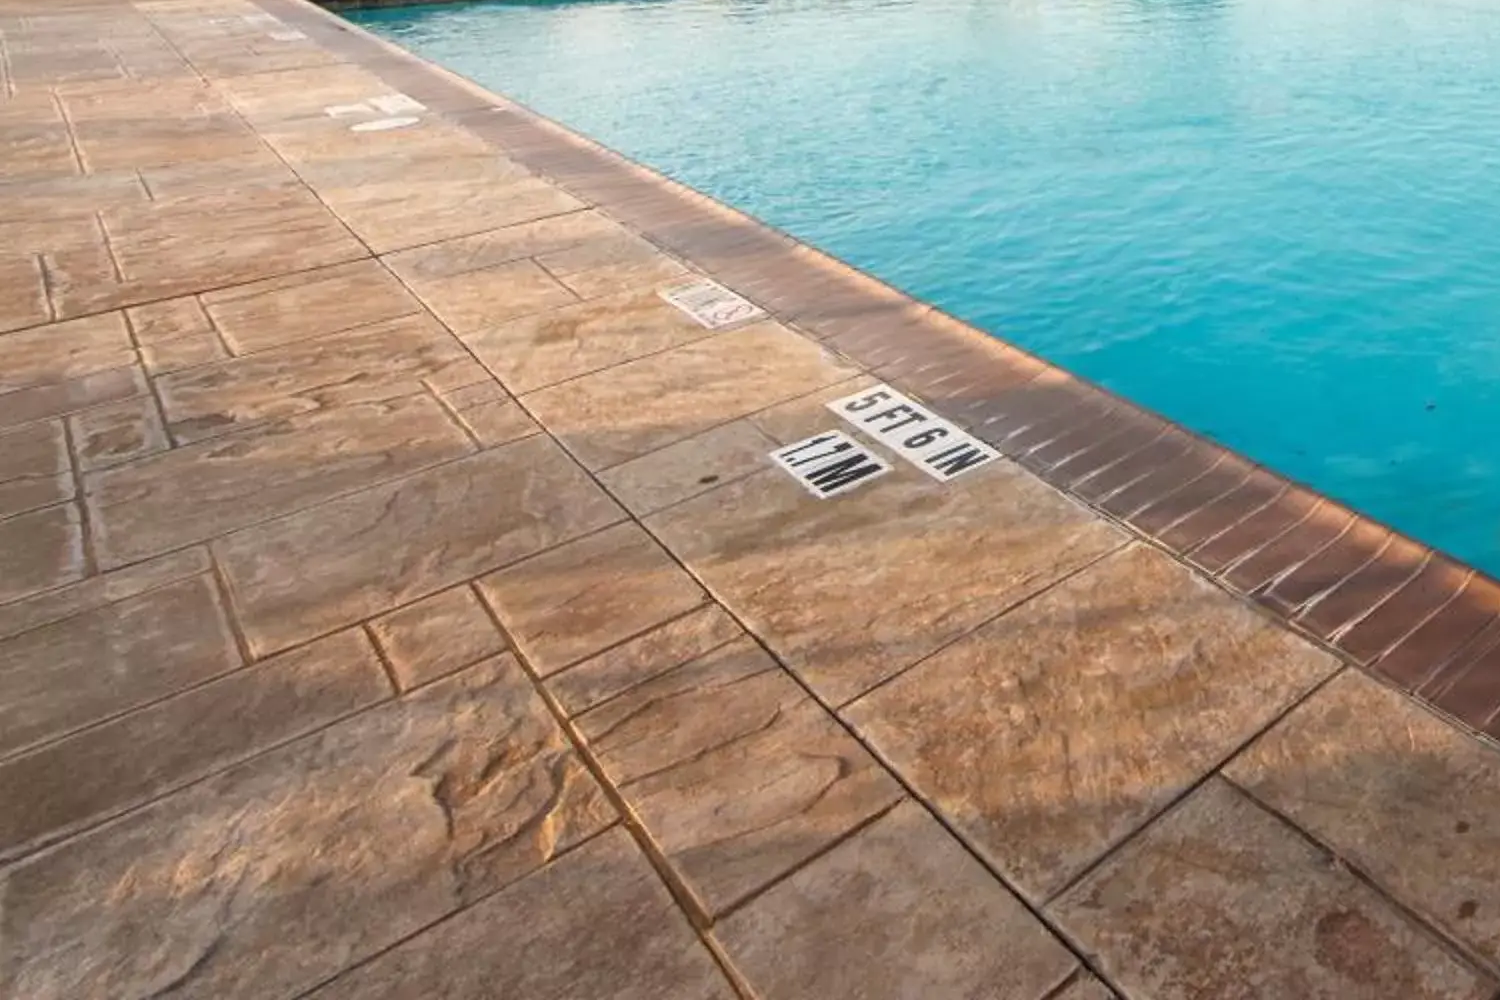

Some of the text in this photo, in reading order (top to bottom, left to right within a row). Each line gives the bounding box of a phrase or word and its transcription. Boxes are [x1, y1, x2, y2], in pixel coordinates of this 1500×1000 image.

[779, 435, 883, 493] 1.7 M
[845, 391, 990, 476] 5 FT 6 IN
